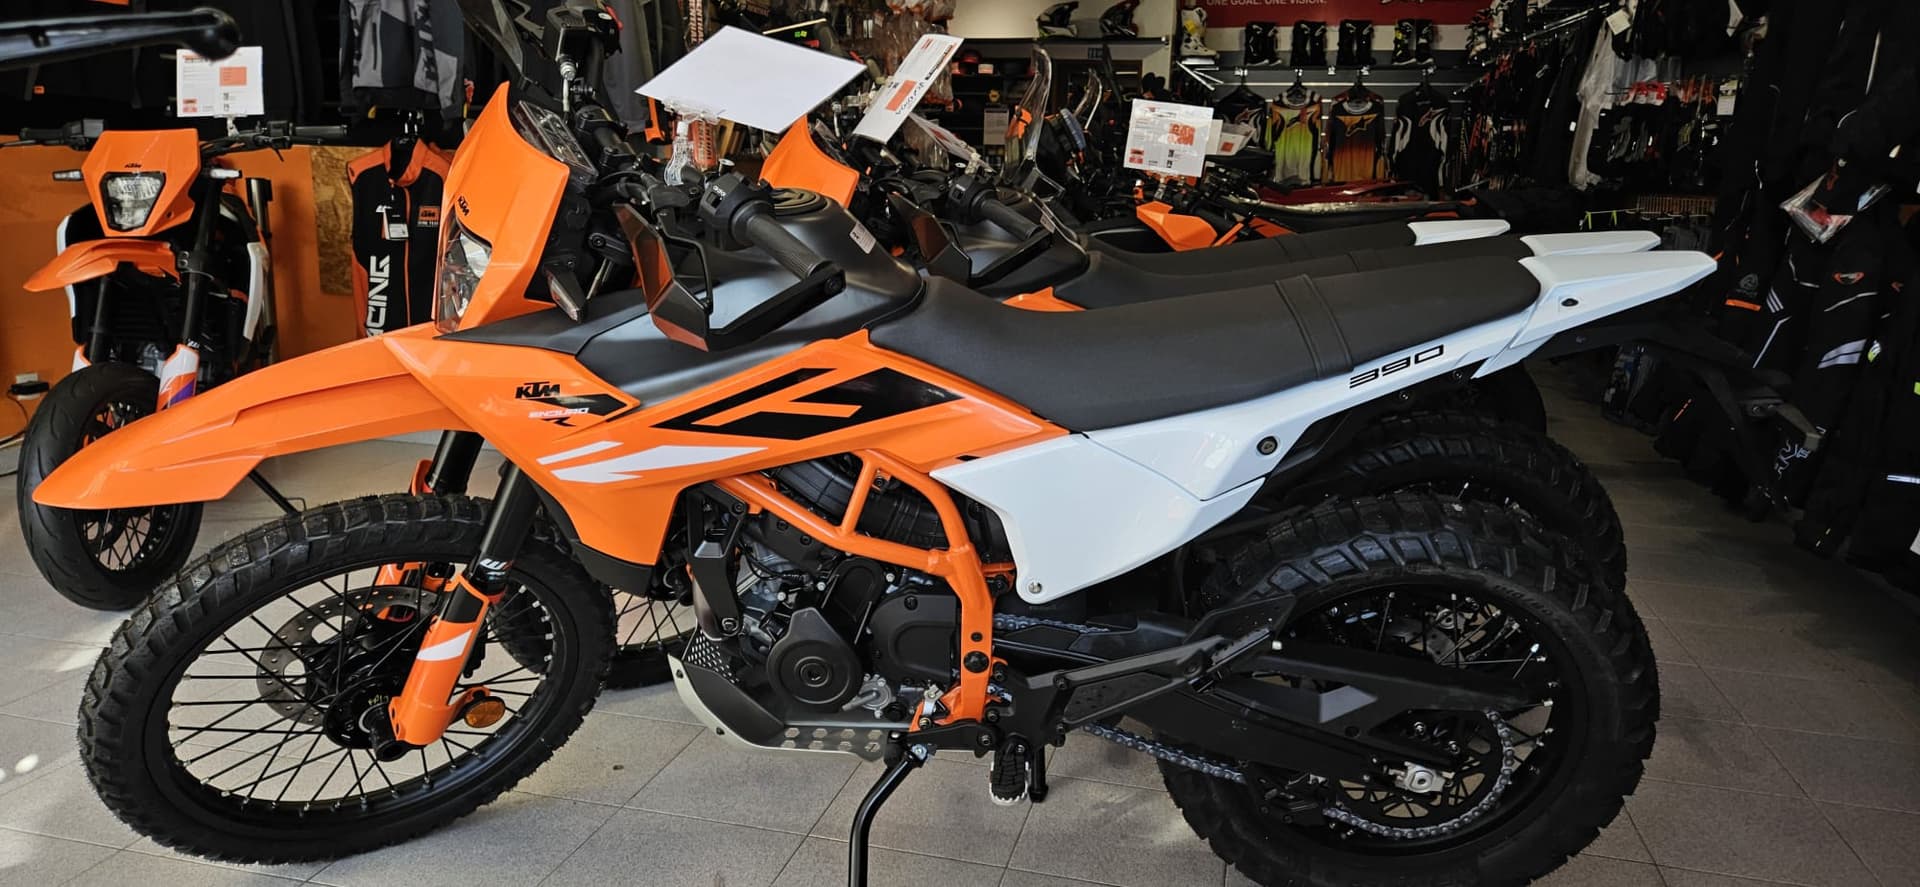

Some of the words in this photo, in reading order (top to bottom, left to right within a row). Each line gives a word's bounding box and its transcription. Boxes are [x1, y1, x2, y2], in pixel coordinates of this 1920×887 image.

[457, 195, 470, 217] KTM
[1349, 344, 1444, 389] 390
[515, 381, 561, 399] KTM
[528, 407, 590, 419] ENDURO
